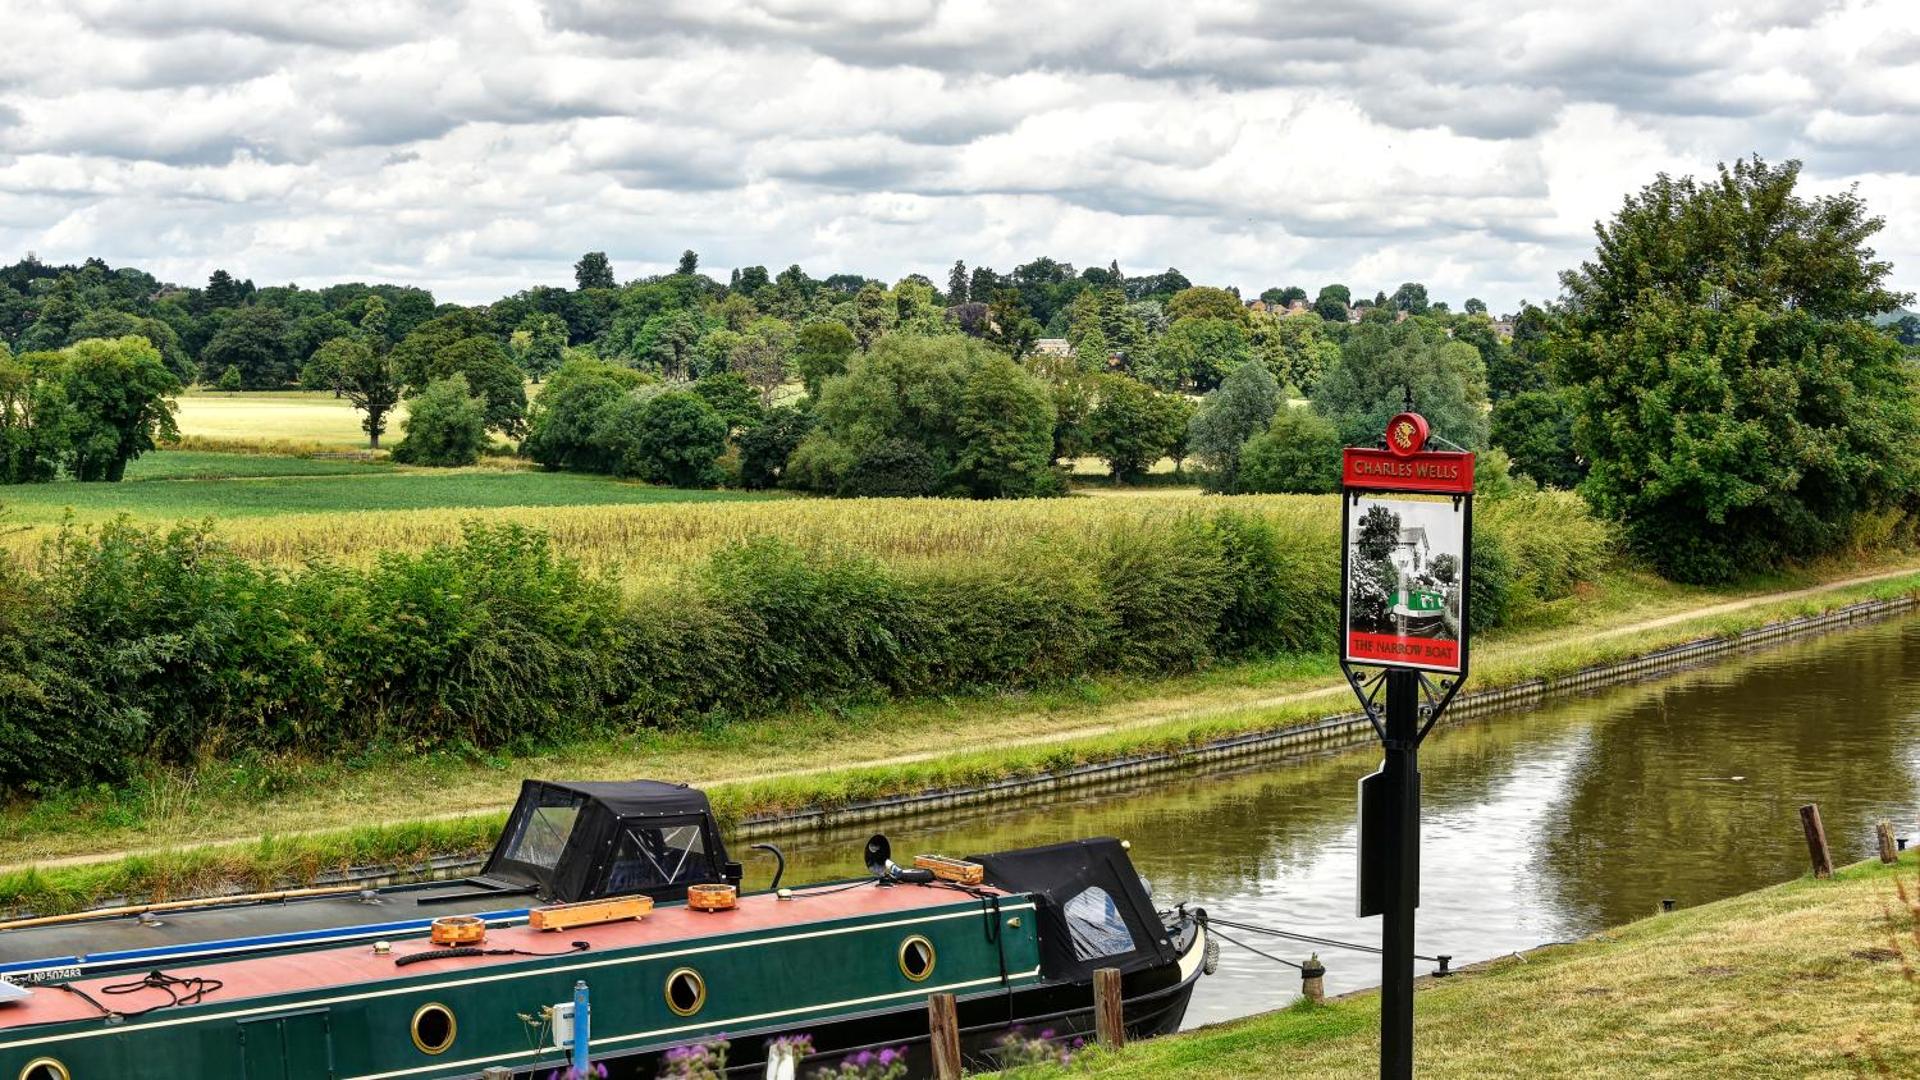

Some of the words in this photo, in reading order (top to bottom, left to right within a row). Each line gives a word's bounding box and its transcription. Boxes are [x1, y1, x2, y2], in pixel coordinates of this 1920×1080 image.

[1354, 460, 1412, 477] CHARLES
[1416, 462, 1458, 479] WELLS
[1354, 639, 1373, 653] THE
[1376, 641, 1423, 656] NARROW
[1425, 646, 1454, 660] BOAT
